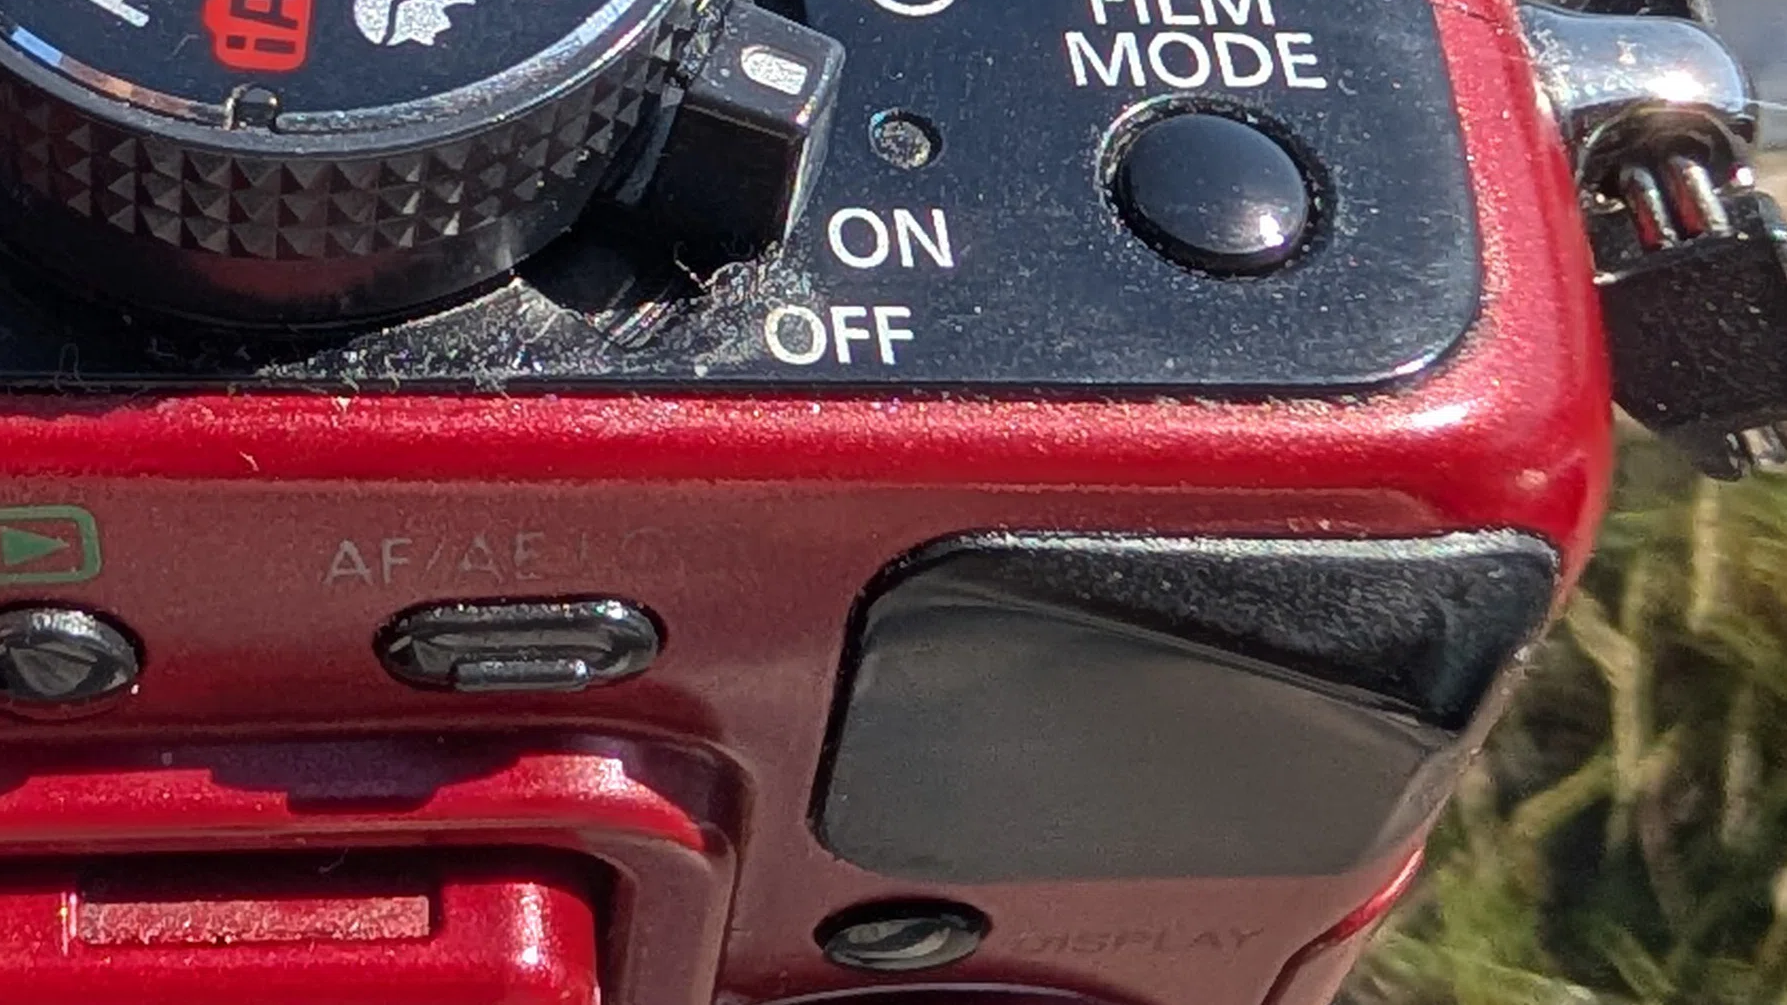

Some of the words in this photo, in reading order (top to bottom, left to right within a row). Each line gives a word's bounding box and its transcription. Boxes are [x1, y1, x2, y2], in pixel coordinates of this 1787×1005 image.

[1064, 31, 1328, 89] MODE
[827, 207, 955, 269] ON
[763, 303, 914, 366] OFF
